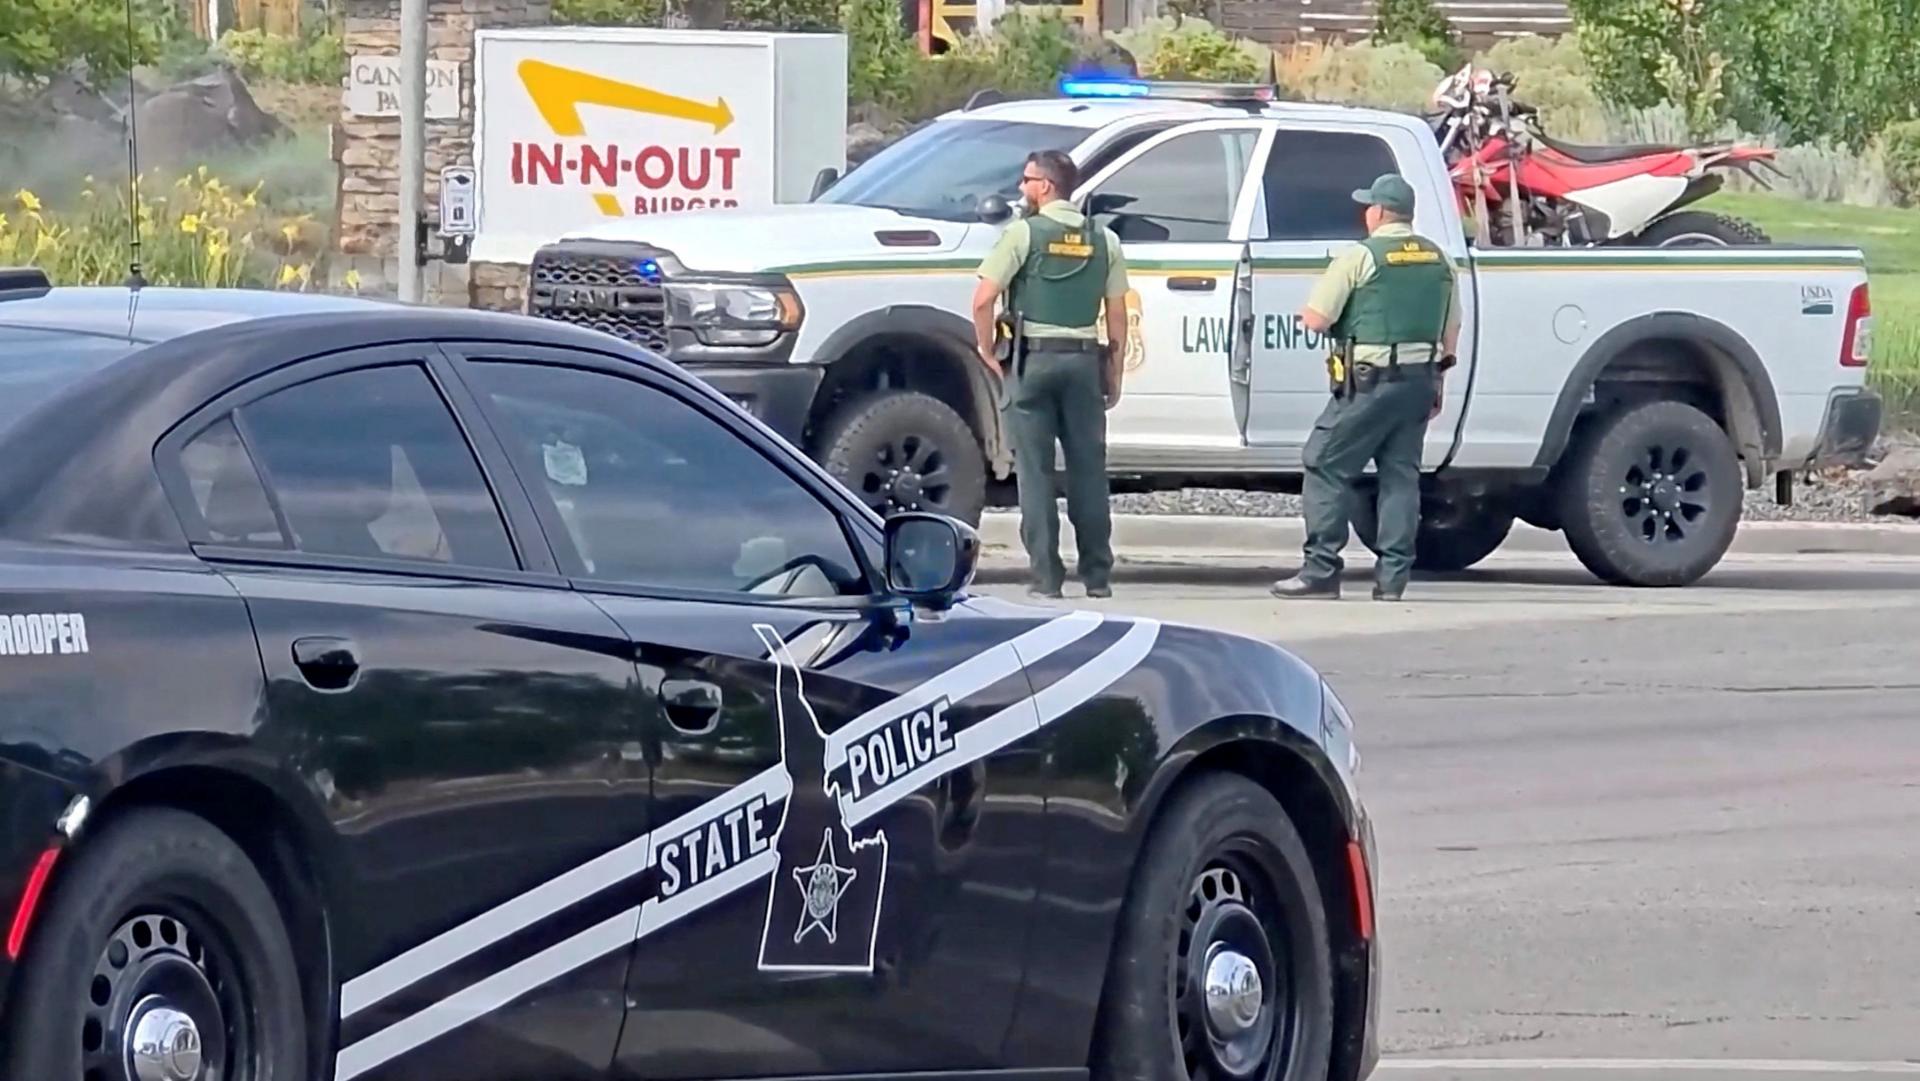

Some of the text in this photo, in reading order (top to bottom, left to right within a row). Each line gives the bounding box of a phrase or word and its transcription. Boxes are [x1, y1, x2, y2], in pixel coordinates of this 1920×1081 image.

[356, 64, 454, 88] CANON
[376, 90, 432, 112] PAK
[511, 142, 740, 190] IN-N-OUT
[661, 797, 768, 896] STATE
[848, 698, 954, 798] POLICE
